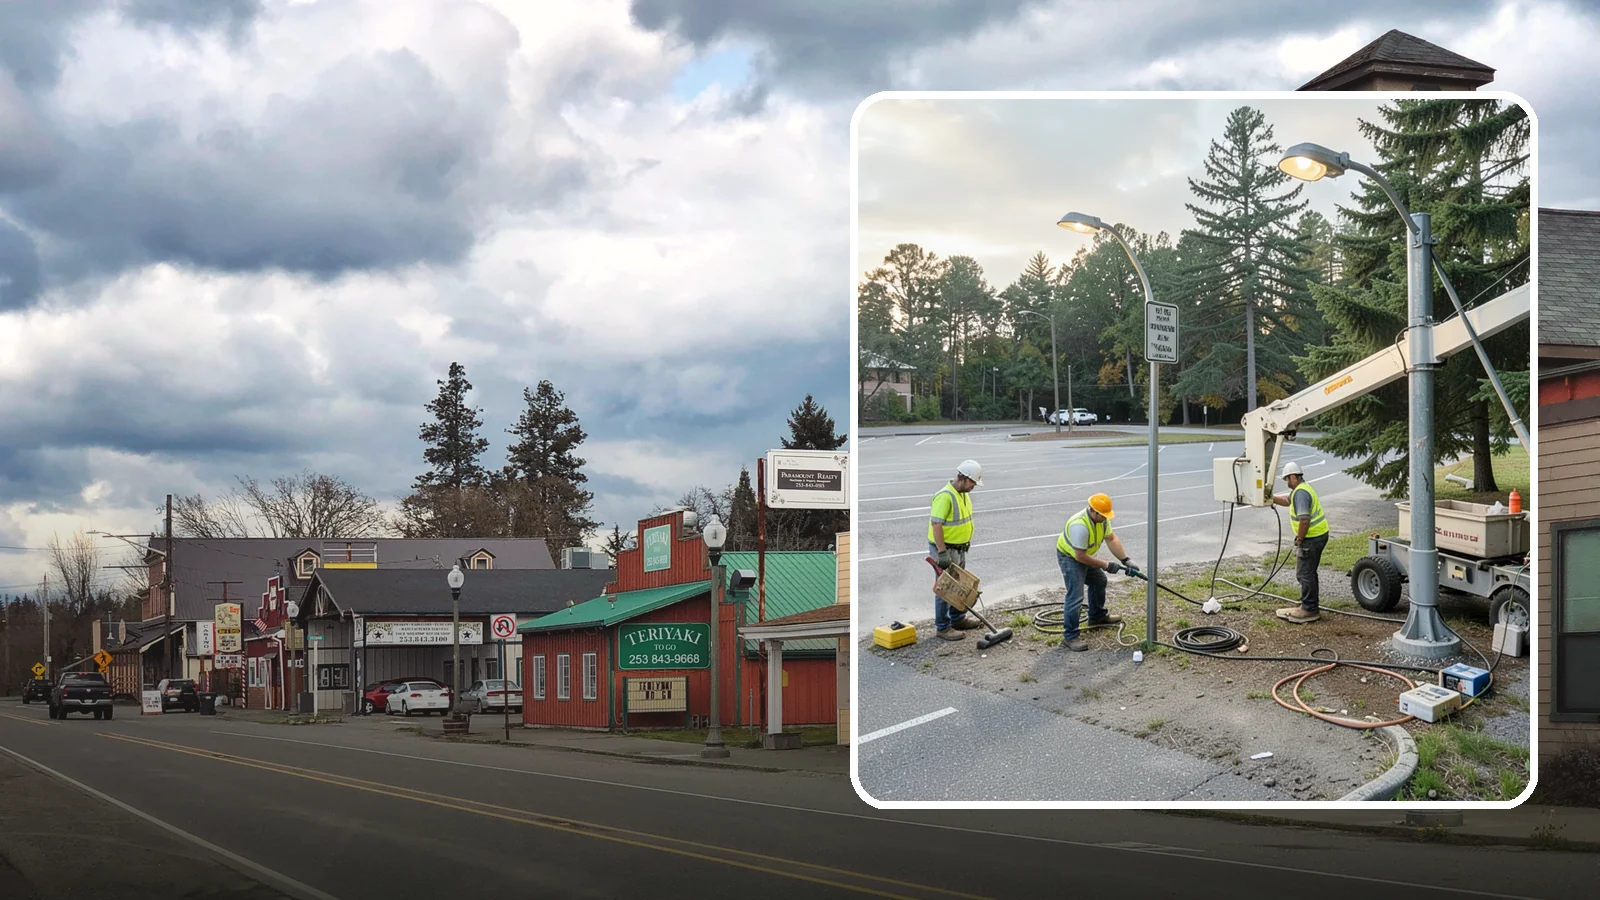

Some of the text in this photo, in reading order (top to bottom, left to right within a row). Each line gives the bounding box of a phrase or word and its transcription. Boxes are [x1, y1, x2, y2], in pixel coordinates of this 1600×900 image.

[624, 627, 702, 646] TERIYAKI
[653, 643, 677, 651] TO GO
[628, 653, 700, 664] 253 843-9668
[639, 681, 673, 691] TERIYAKI
